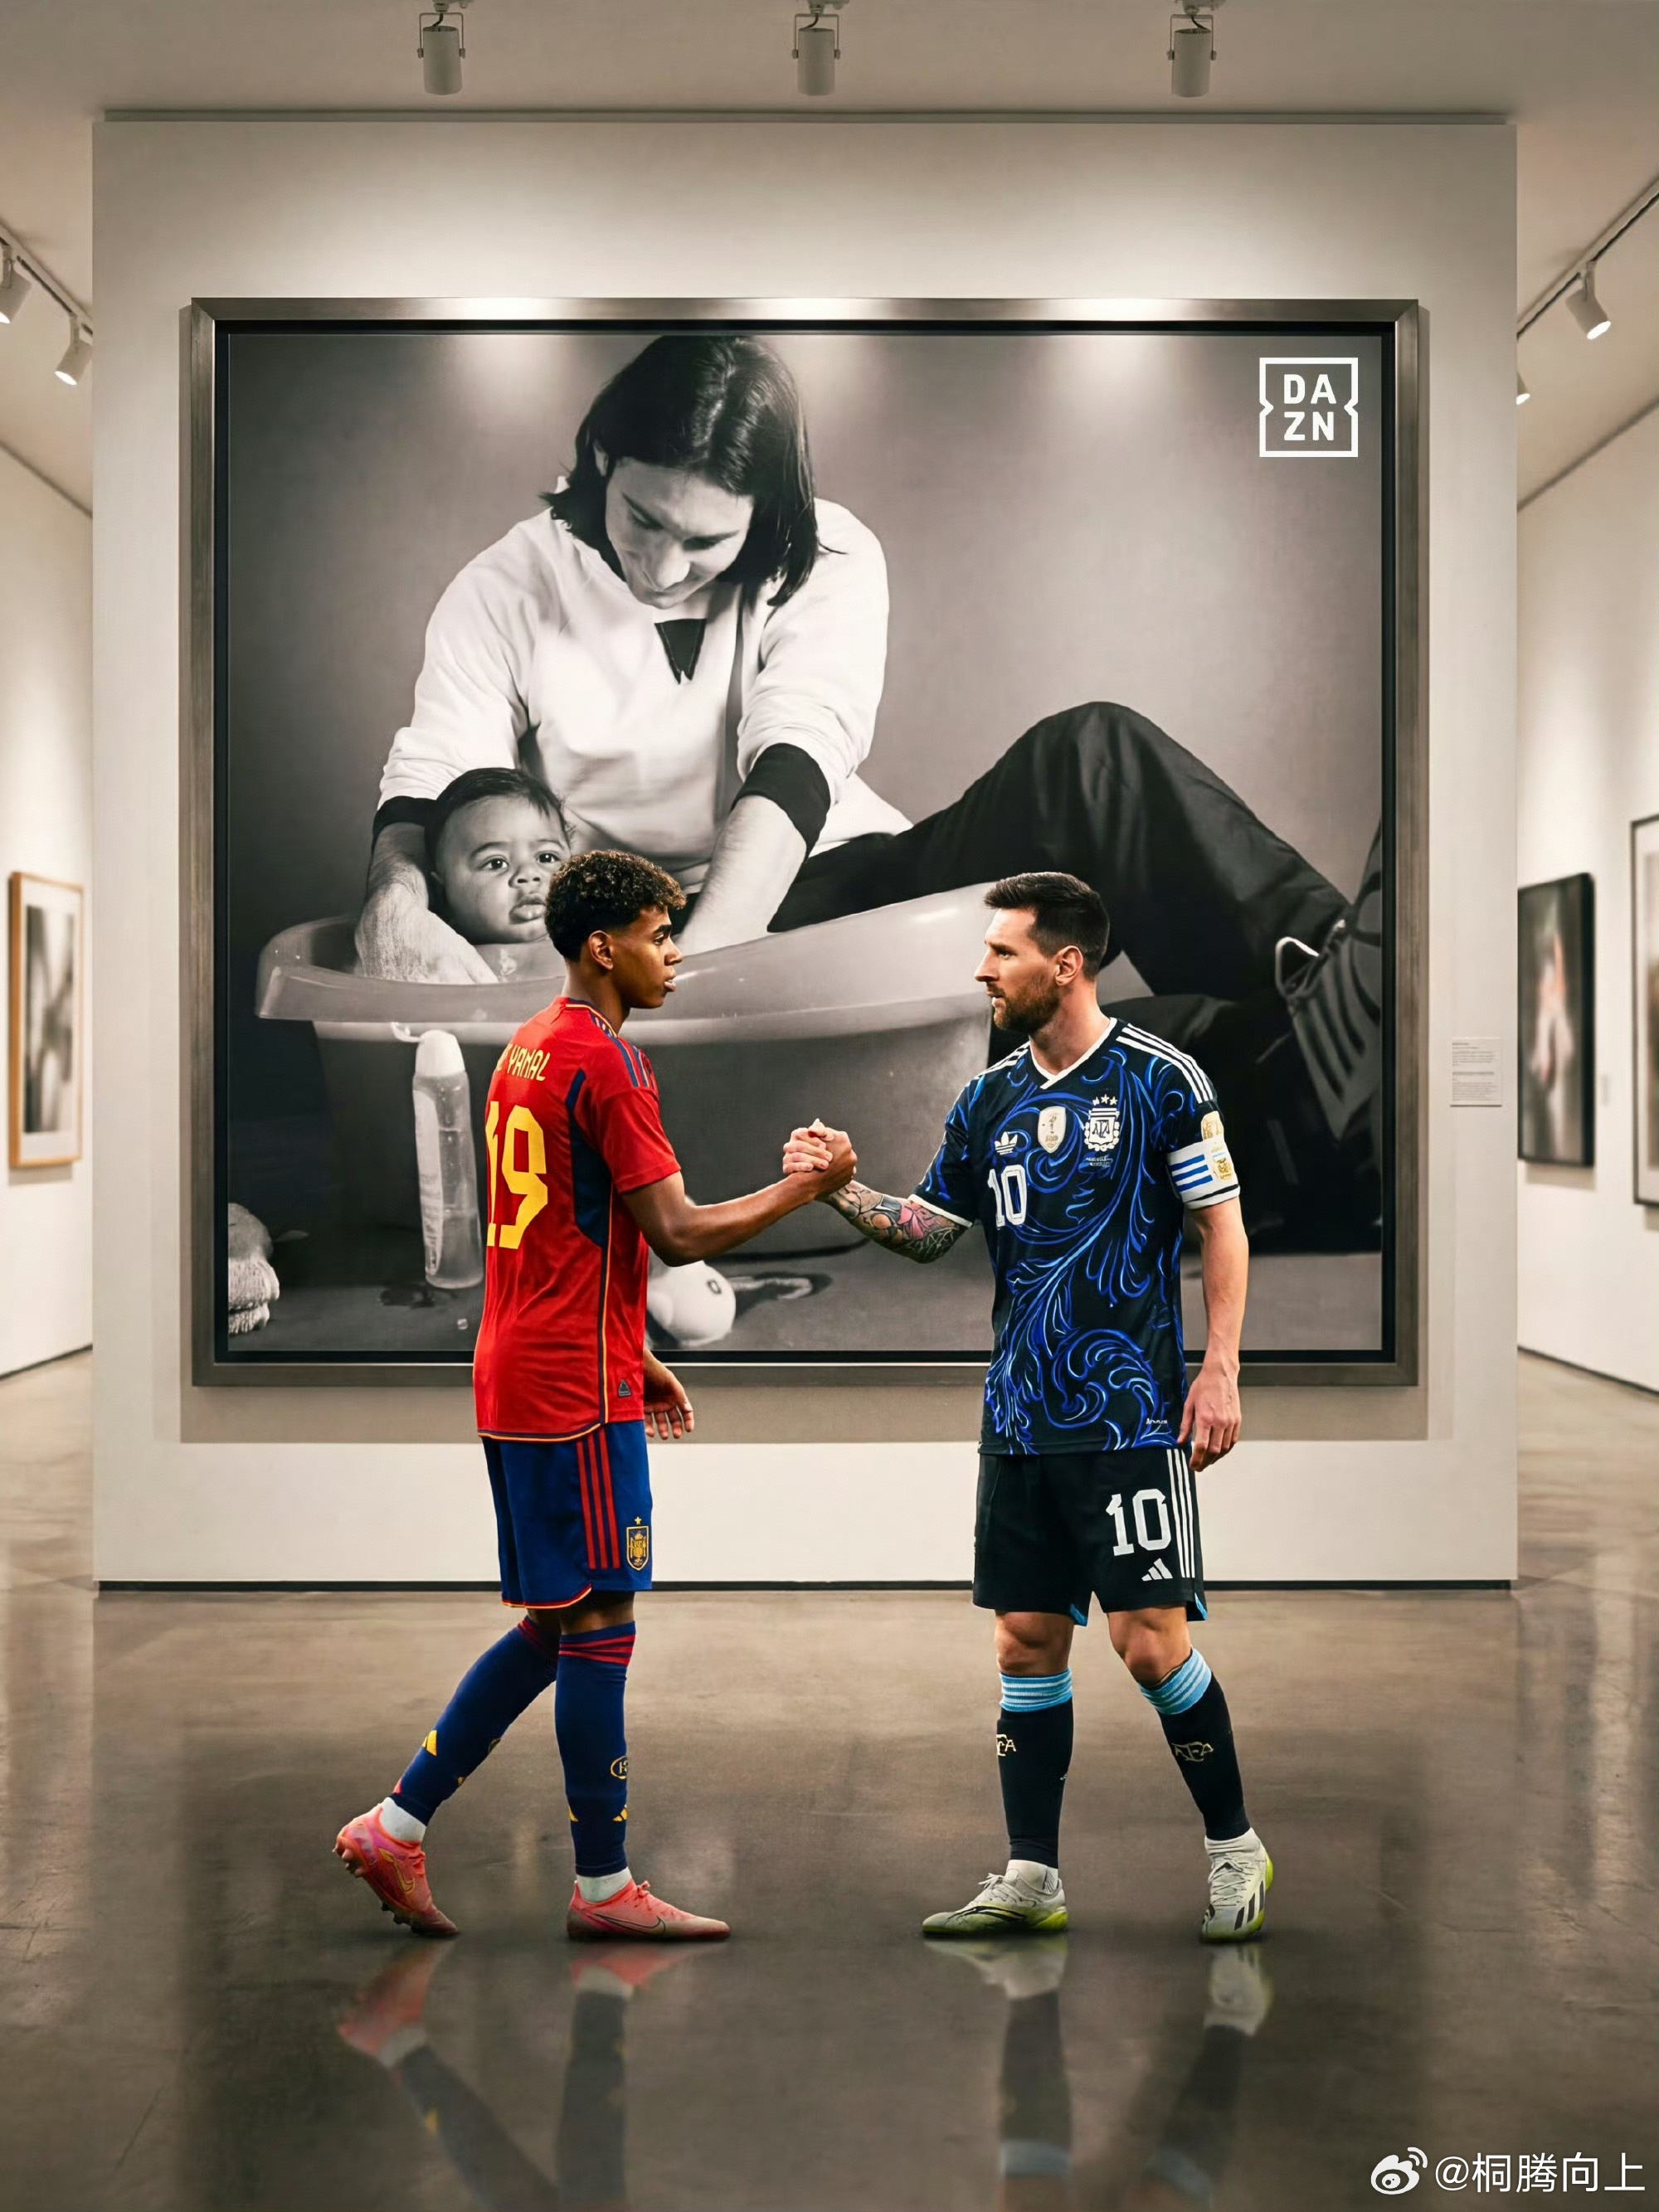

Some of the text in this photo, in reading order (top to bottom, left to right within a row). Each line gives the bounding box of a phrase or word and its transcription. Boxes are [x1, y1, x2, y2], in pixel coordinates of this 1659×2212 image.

[485, 1101, 547, 1249] 19
[987, 1164, 1027, 1227] 10
[1106, 1489, 1171, 1556] 10
